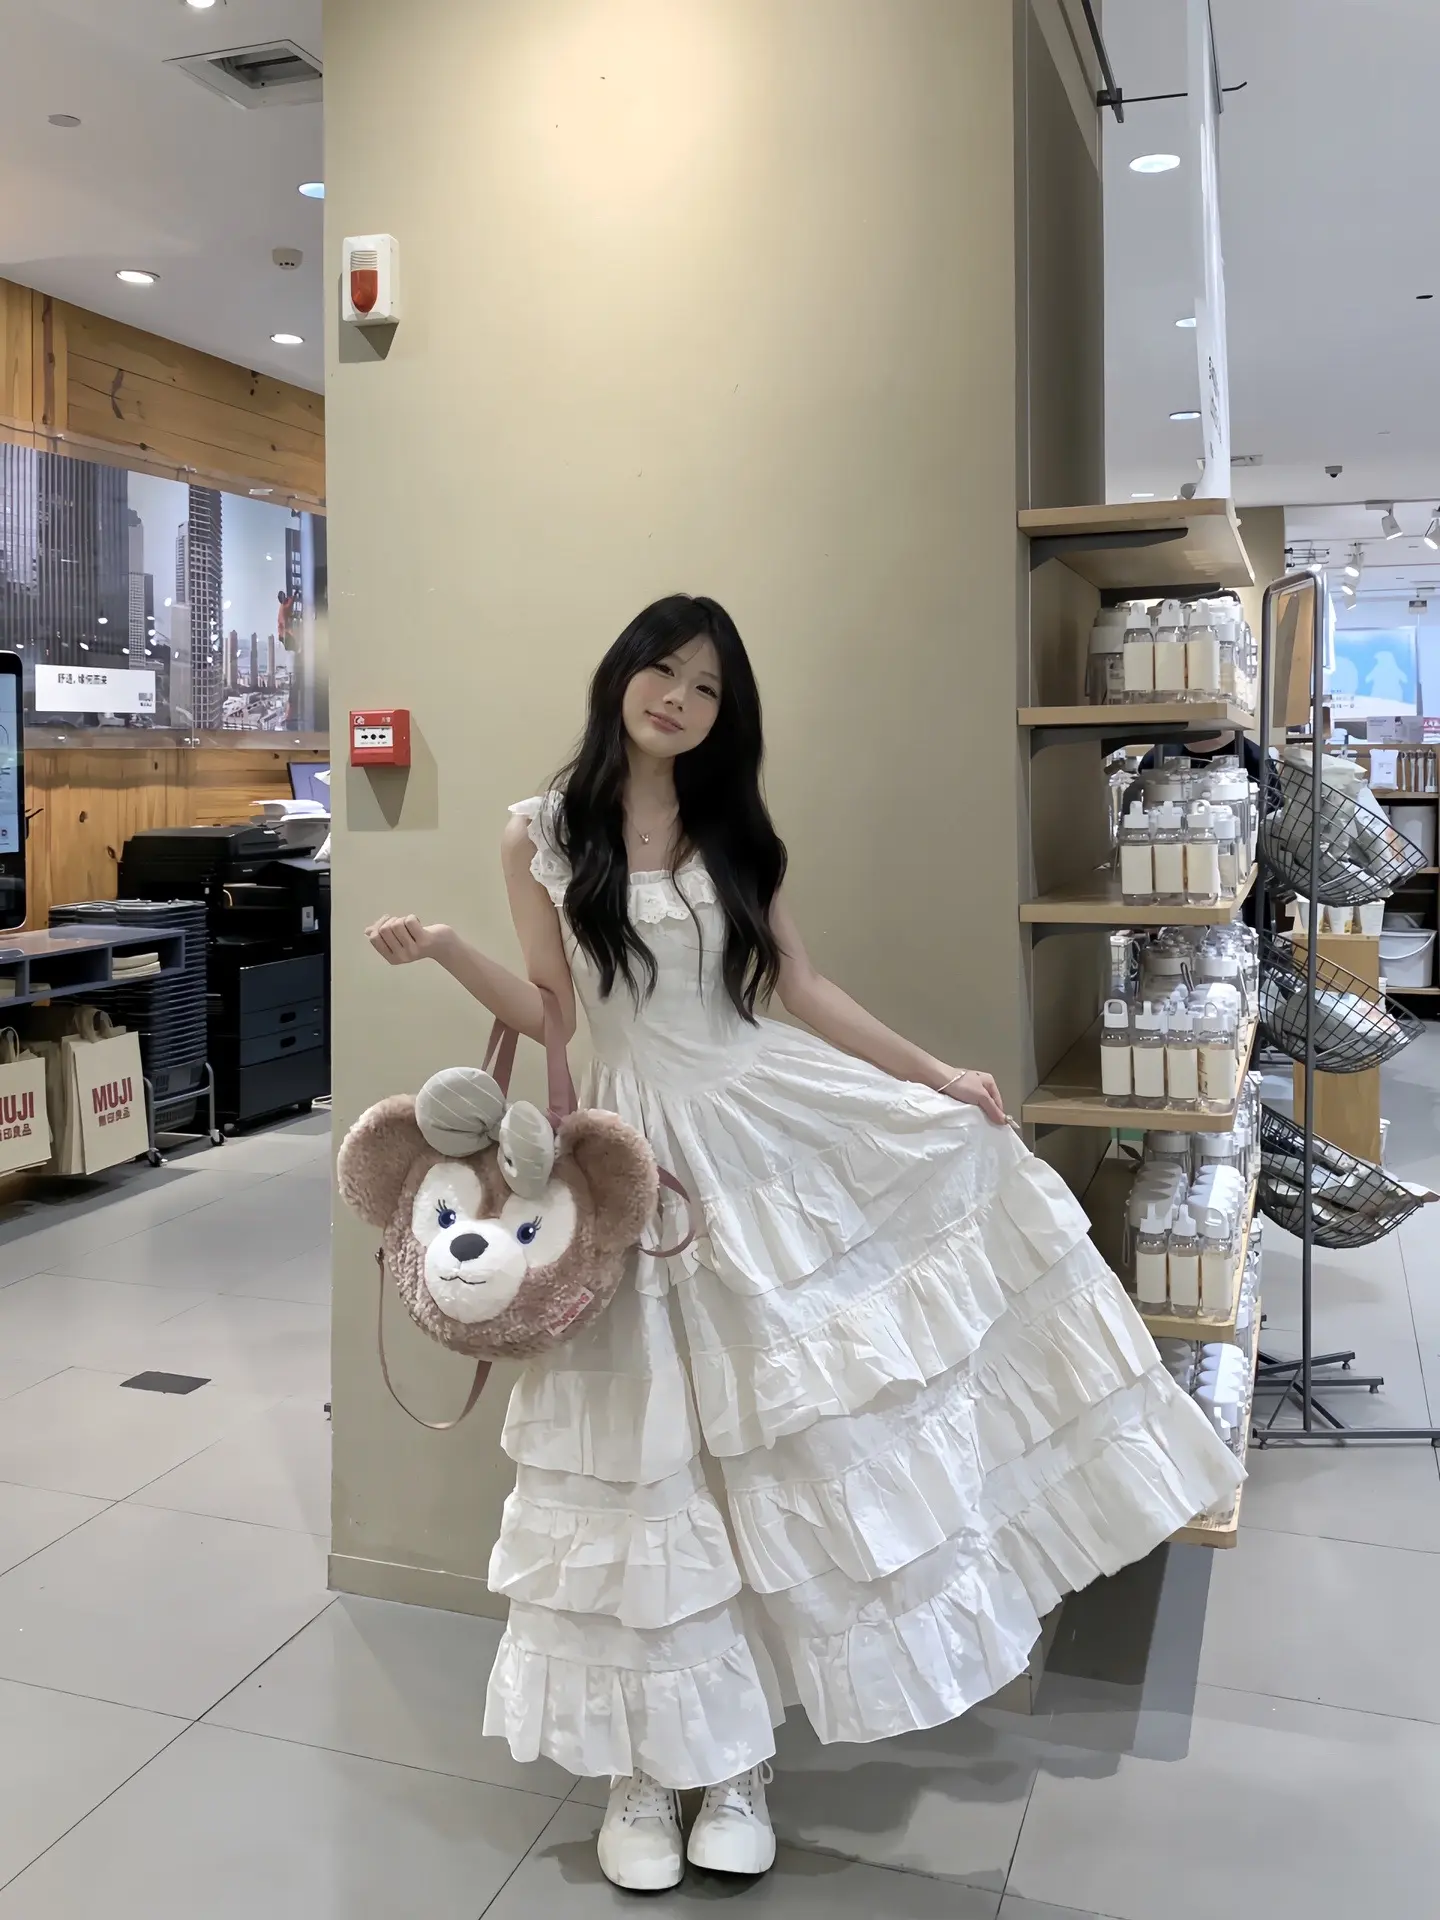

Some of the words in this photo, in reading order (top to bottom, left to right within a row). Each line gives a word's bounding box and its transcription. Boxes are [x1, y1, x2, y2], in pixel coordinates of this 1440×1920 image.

[0, 1091, 34, 1125] UJI
[92, 1076, 132, 1114] MUJI
[0, 1123, 32, 1141] 印良品
